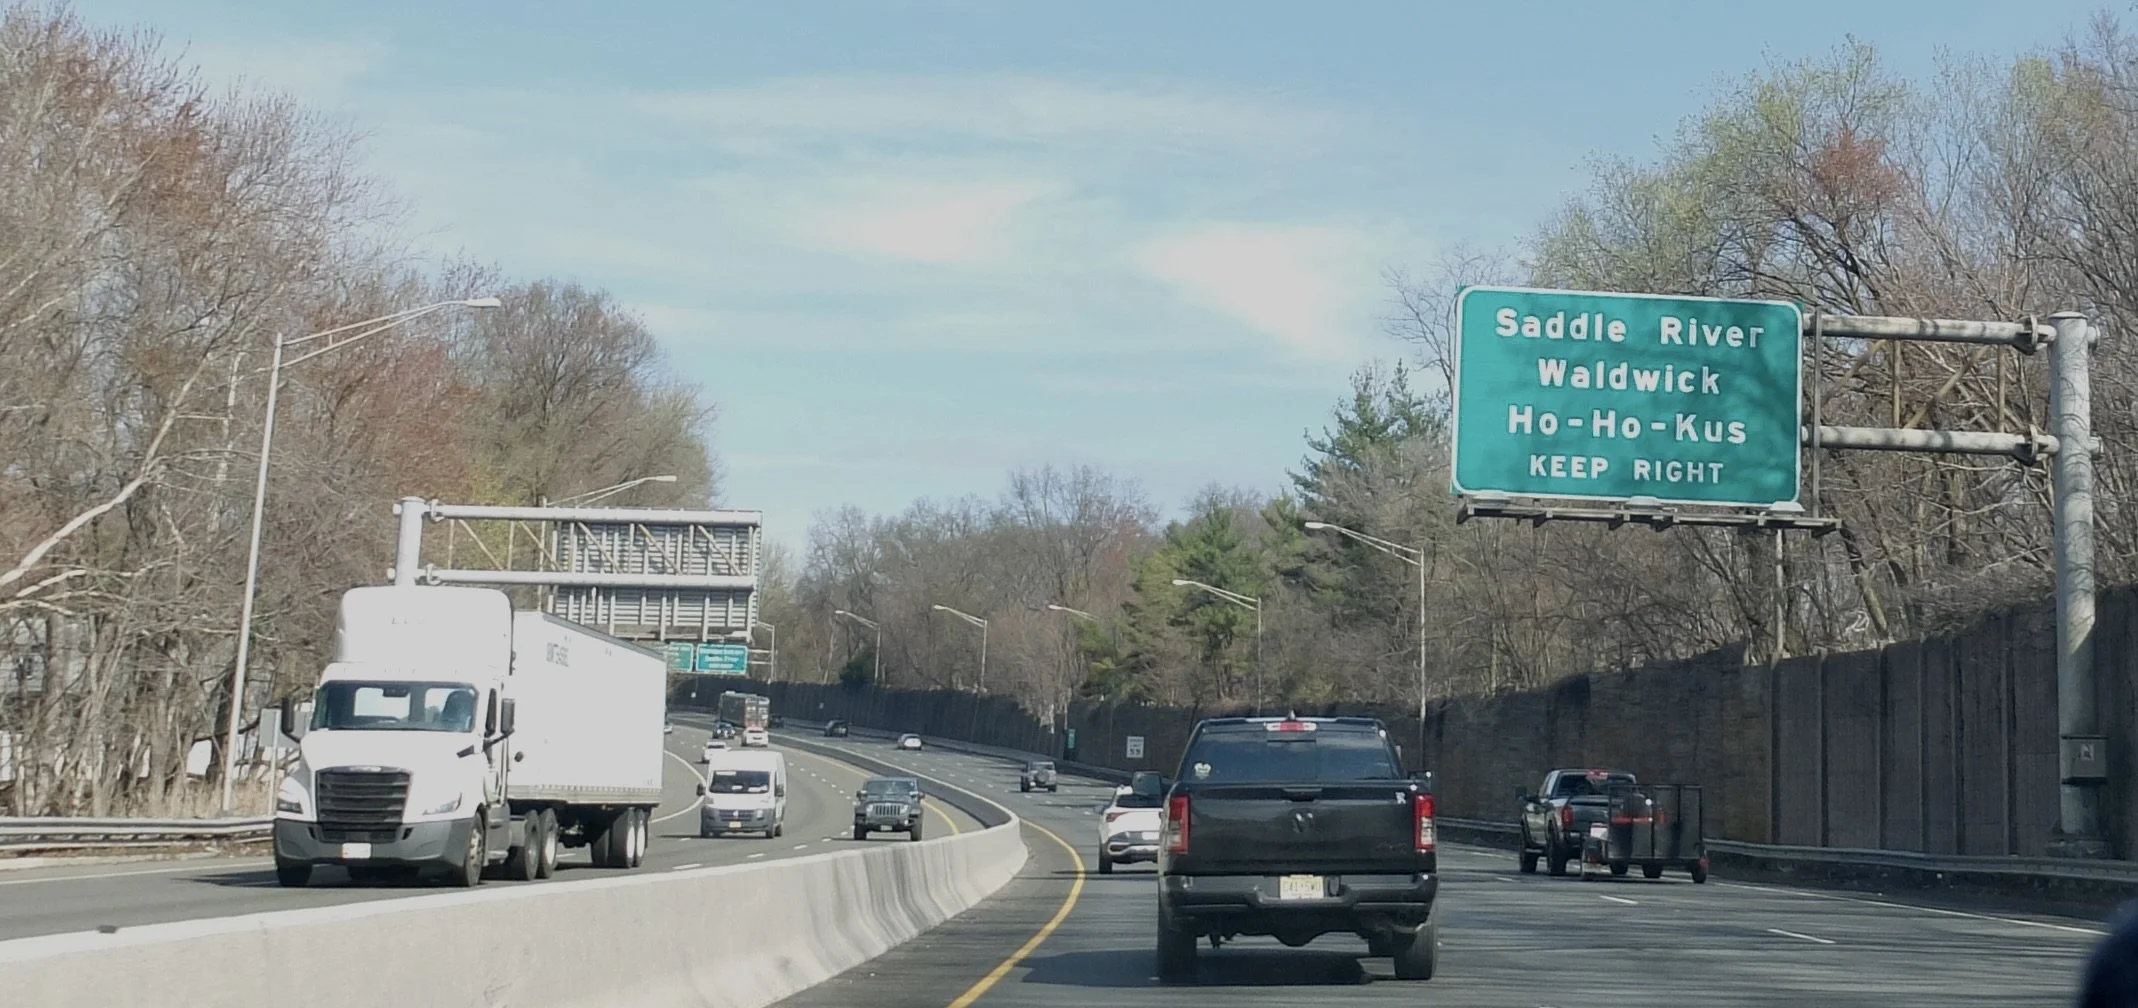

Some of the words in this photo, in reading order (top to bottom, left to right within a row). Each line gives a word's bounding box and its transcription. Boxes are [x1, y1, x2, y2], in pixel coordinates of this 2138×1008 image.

[1495, 307, 1627, 342] Saddle
[1660, 316, 1766, 348] River
[1538, 358, 1721, 395] Waldwick
[1508, 405, 1747, 444] Ho-Ho-Kus
[1530, 454, 1609, 480] KEEP
[1634, 459, 1724, 484] RIGHT
